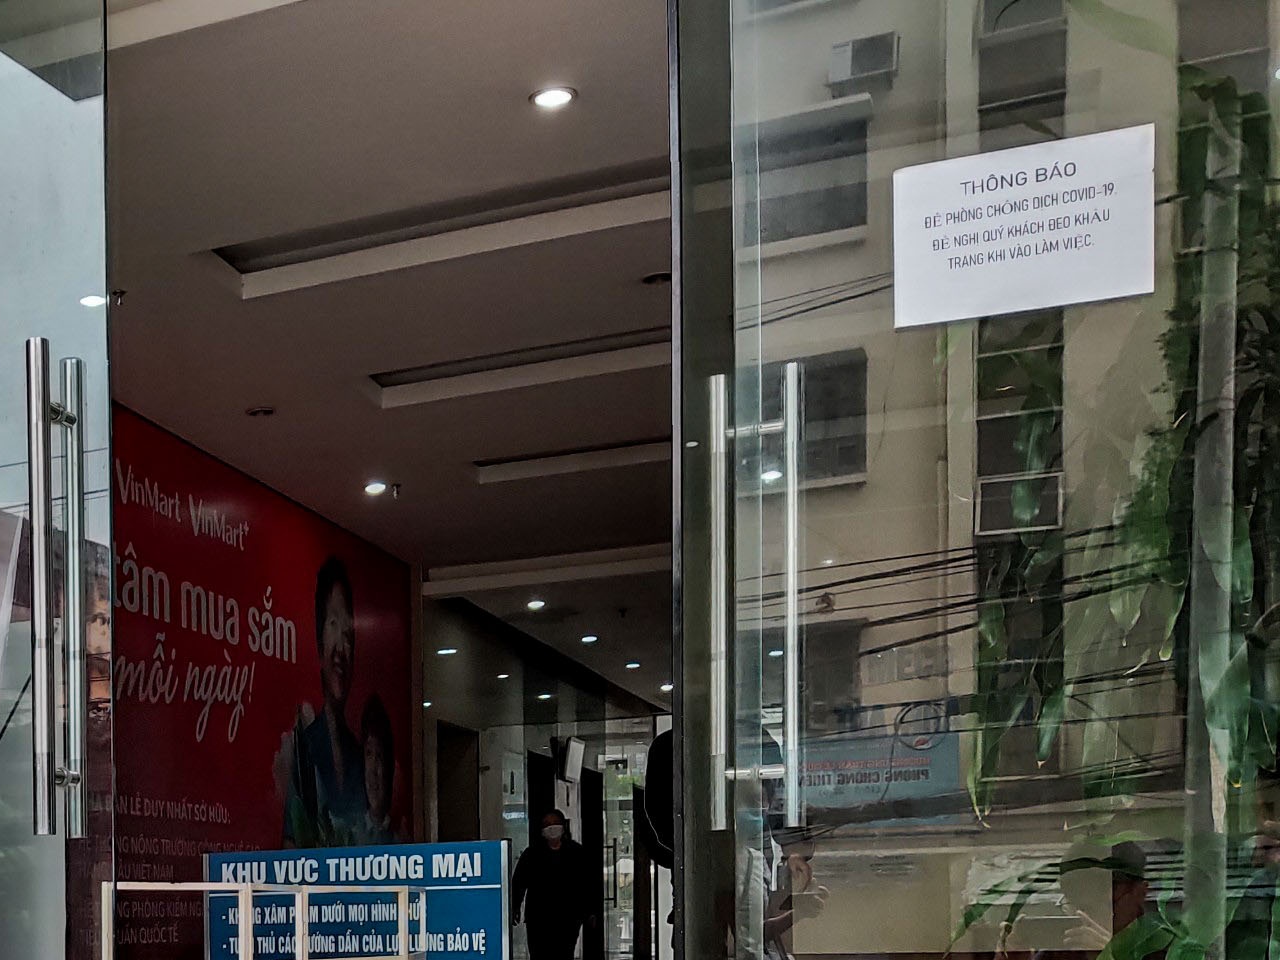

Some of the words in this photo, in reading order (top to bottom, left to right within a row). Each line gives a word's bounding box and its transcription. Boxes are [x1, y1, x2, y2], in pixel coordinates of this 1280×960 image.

[960, 171, 1028, 196] THÔNG
[1035, 161, 1077, 183] BÁO
[945, 207, 983, 225] PHÒNG
[982, 224, 1005, 242] QUÝ
[1007, 220, 1045, 239] KHÁCH
[1048, 216, 1071, 231] ĐEO
[947, 253, 984, 270] TRANG
[987, 249, 1006, 263] KHI
[1009, 243, 1032, 260] VÀO
[1035, 239, 1059, 256] LÀM
[115, 457, 181, 523] VinMart
[180, 580, 240, 646] mua
[248, 585, 297, 664] sắm
[114, 632, 179, 705] mỗi
[183, 648, 256, 743] ngày!
[221, 861, 267, 884] KHU
[273, 857, 319, 884] VỰC
[326, 854, 424, 881] THƯƠNG
[432, 853, 482, 882] MẠI
[263, 903, 287, 924] XÂM
[321, 900, 346, 923] DƯỚI
[348, 904, 368, 926] MỌI
[371, 899, 397, 921] HÌNH
[256, 931, 276, 954] THỦ
[338, 929, 360, 953] DẪN
[362, 928, 384, 953] CỦA
[447, 926, 470, 952] BẢO
[471, 928, 486, 955] VỆ
